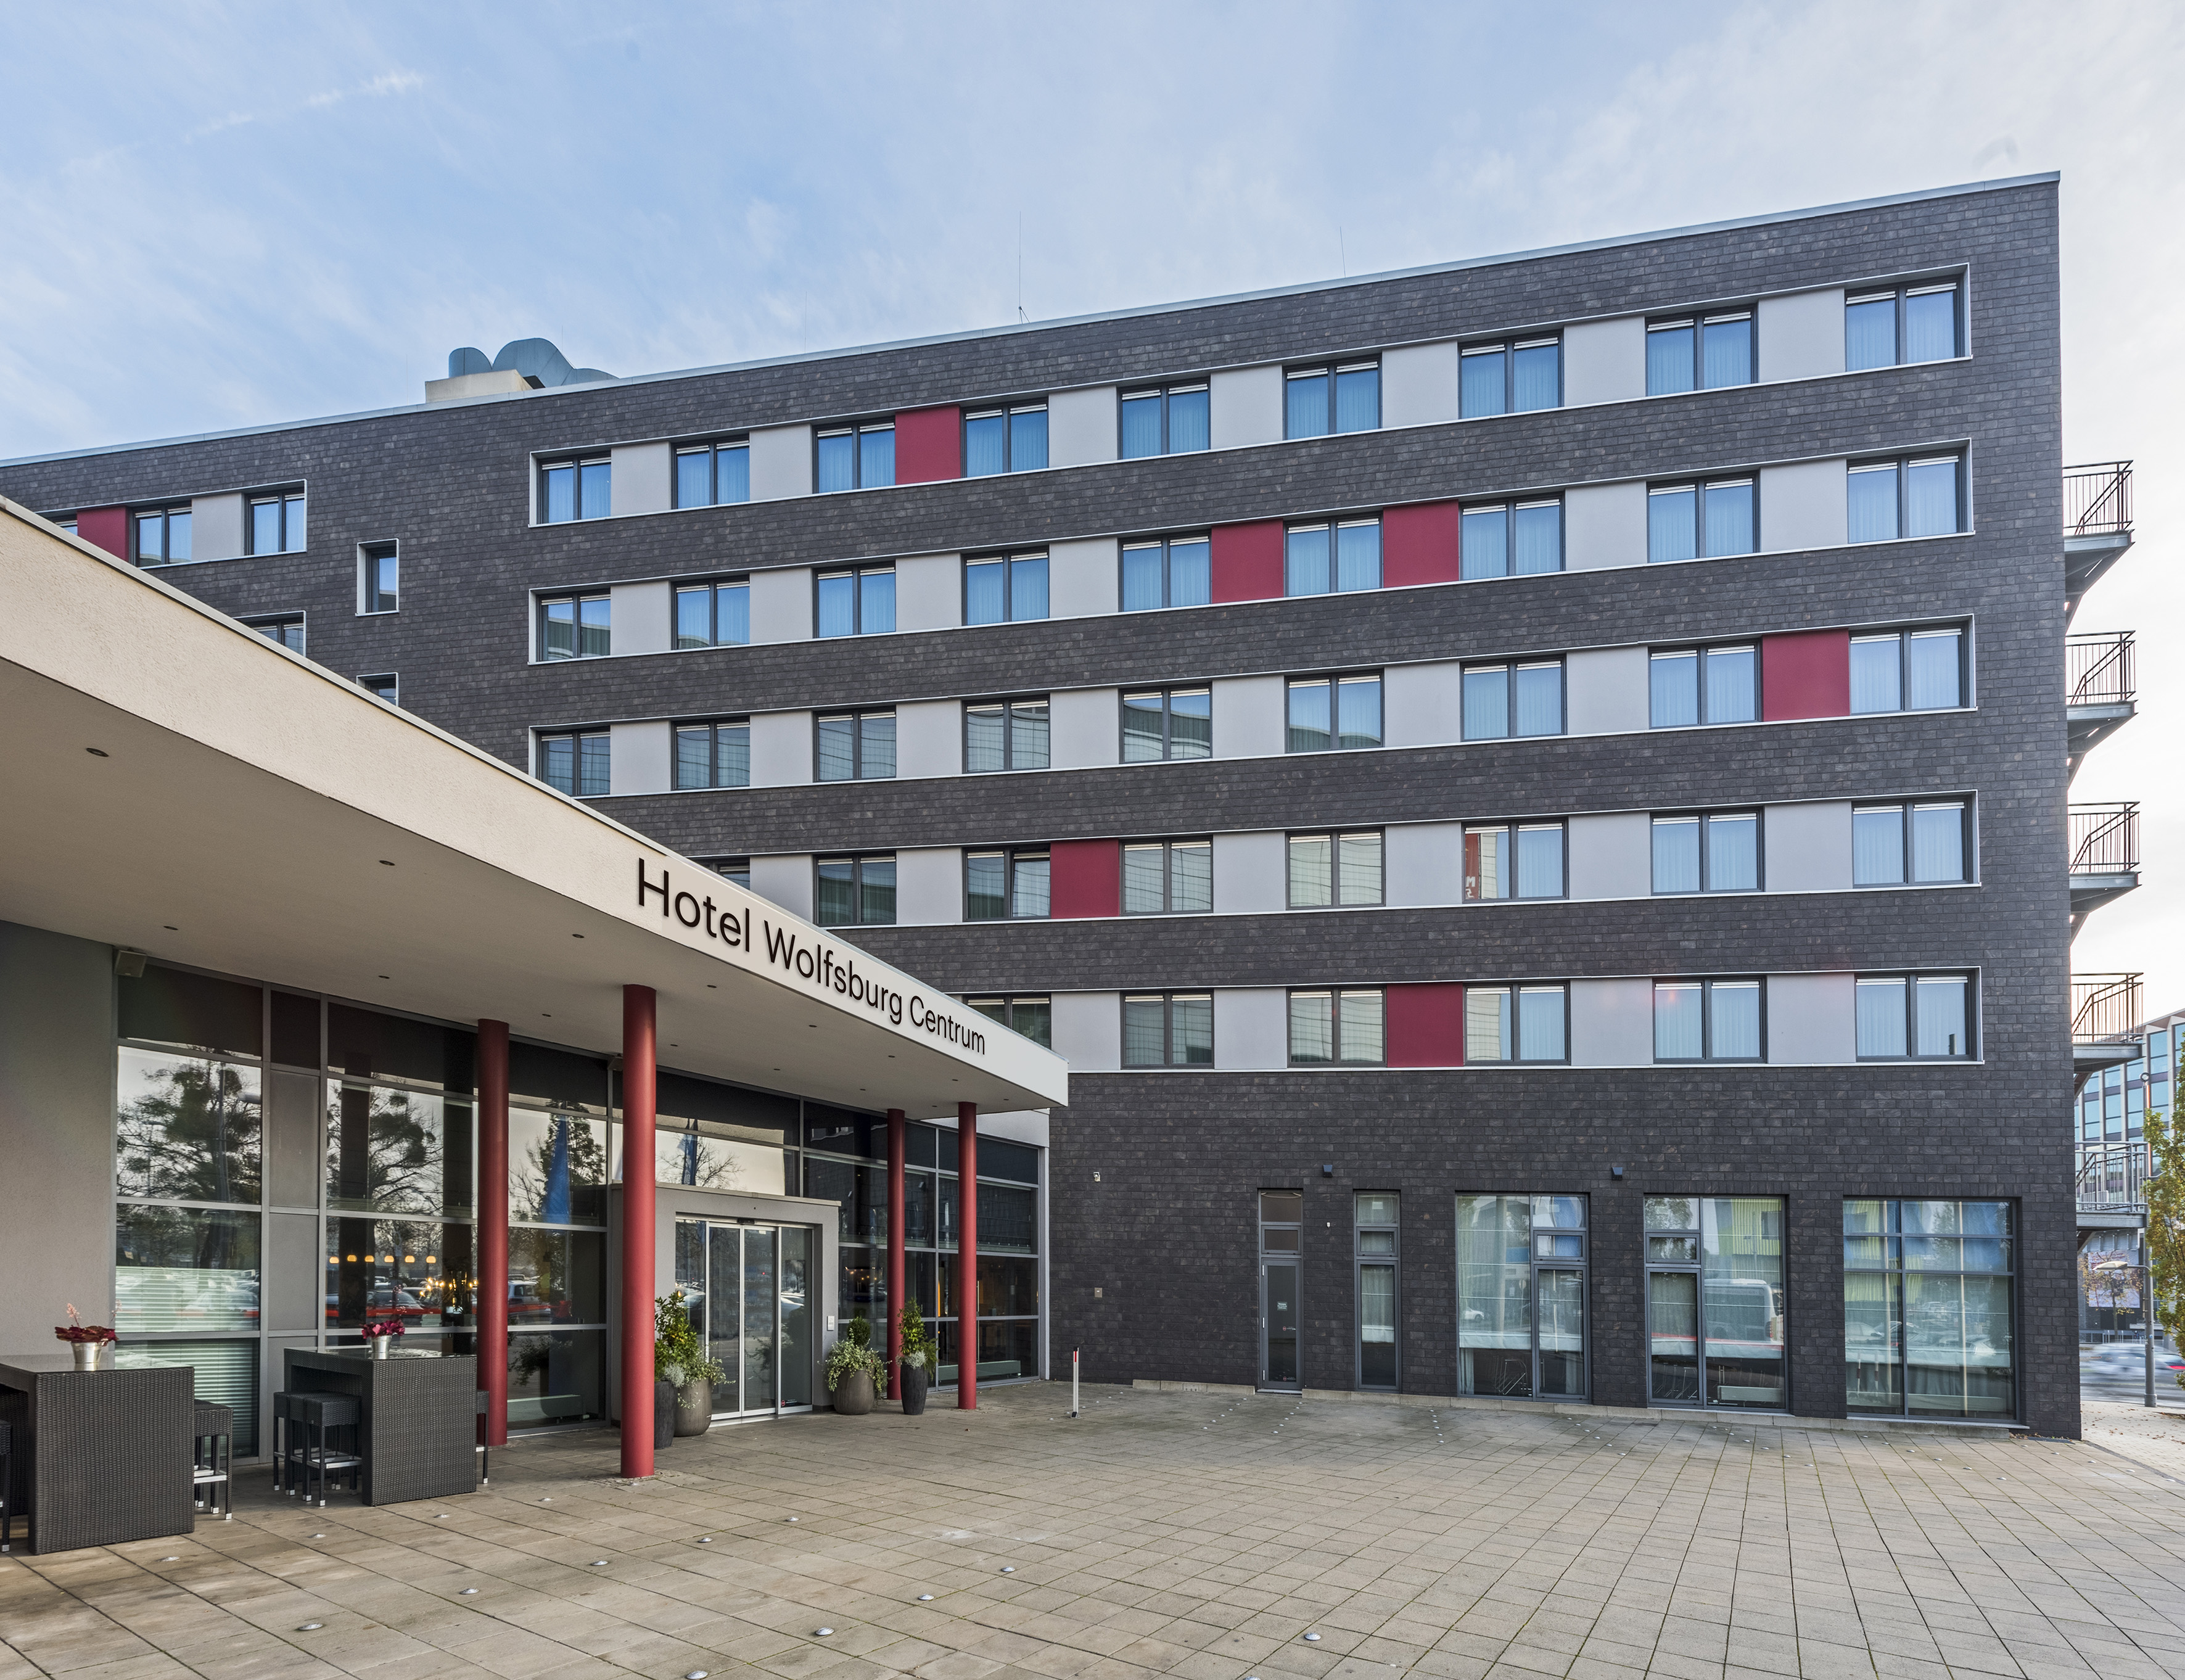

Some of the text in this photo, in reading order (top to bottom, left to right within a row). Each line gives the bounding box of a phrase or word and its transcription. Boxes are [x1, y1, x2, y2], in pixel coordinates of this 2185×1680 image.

[638, 857, 986, 1055] Hotel Wolfsburg Centrum
